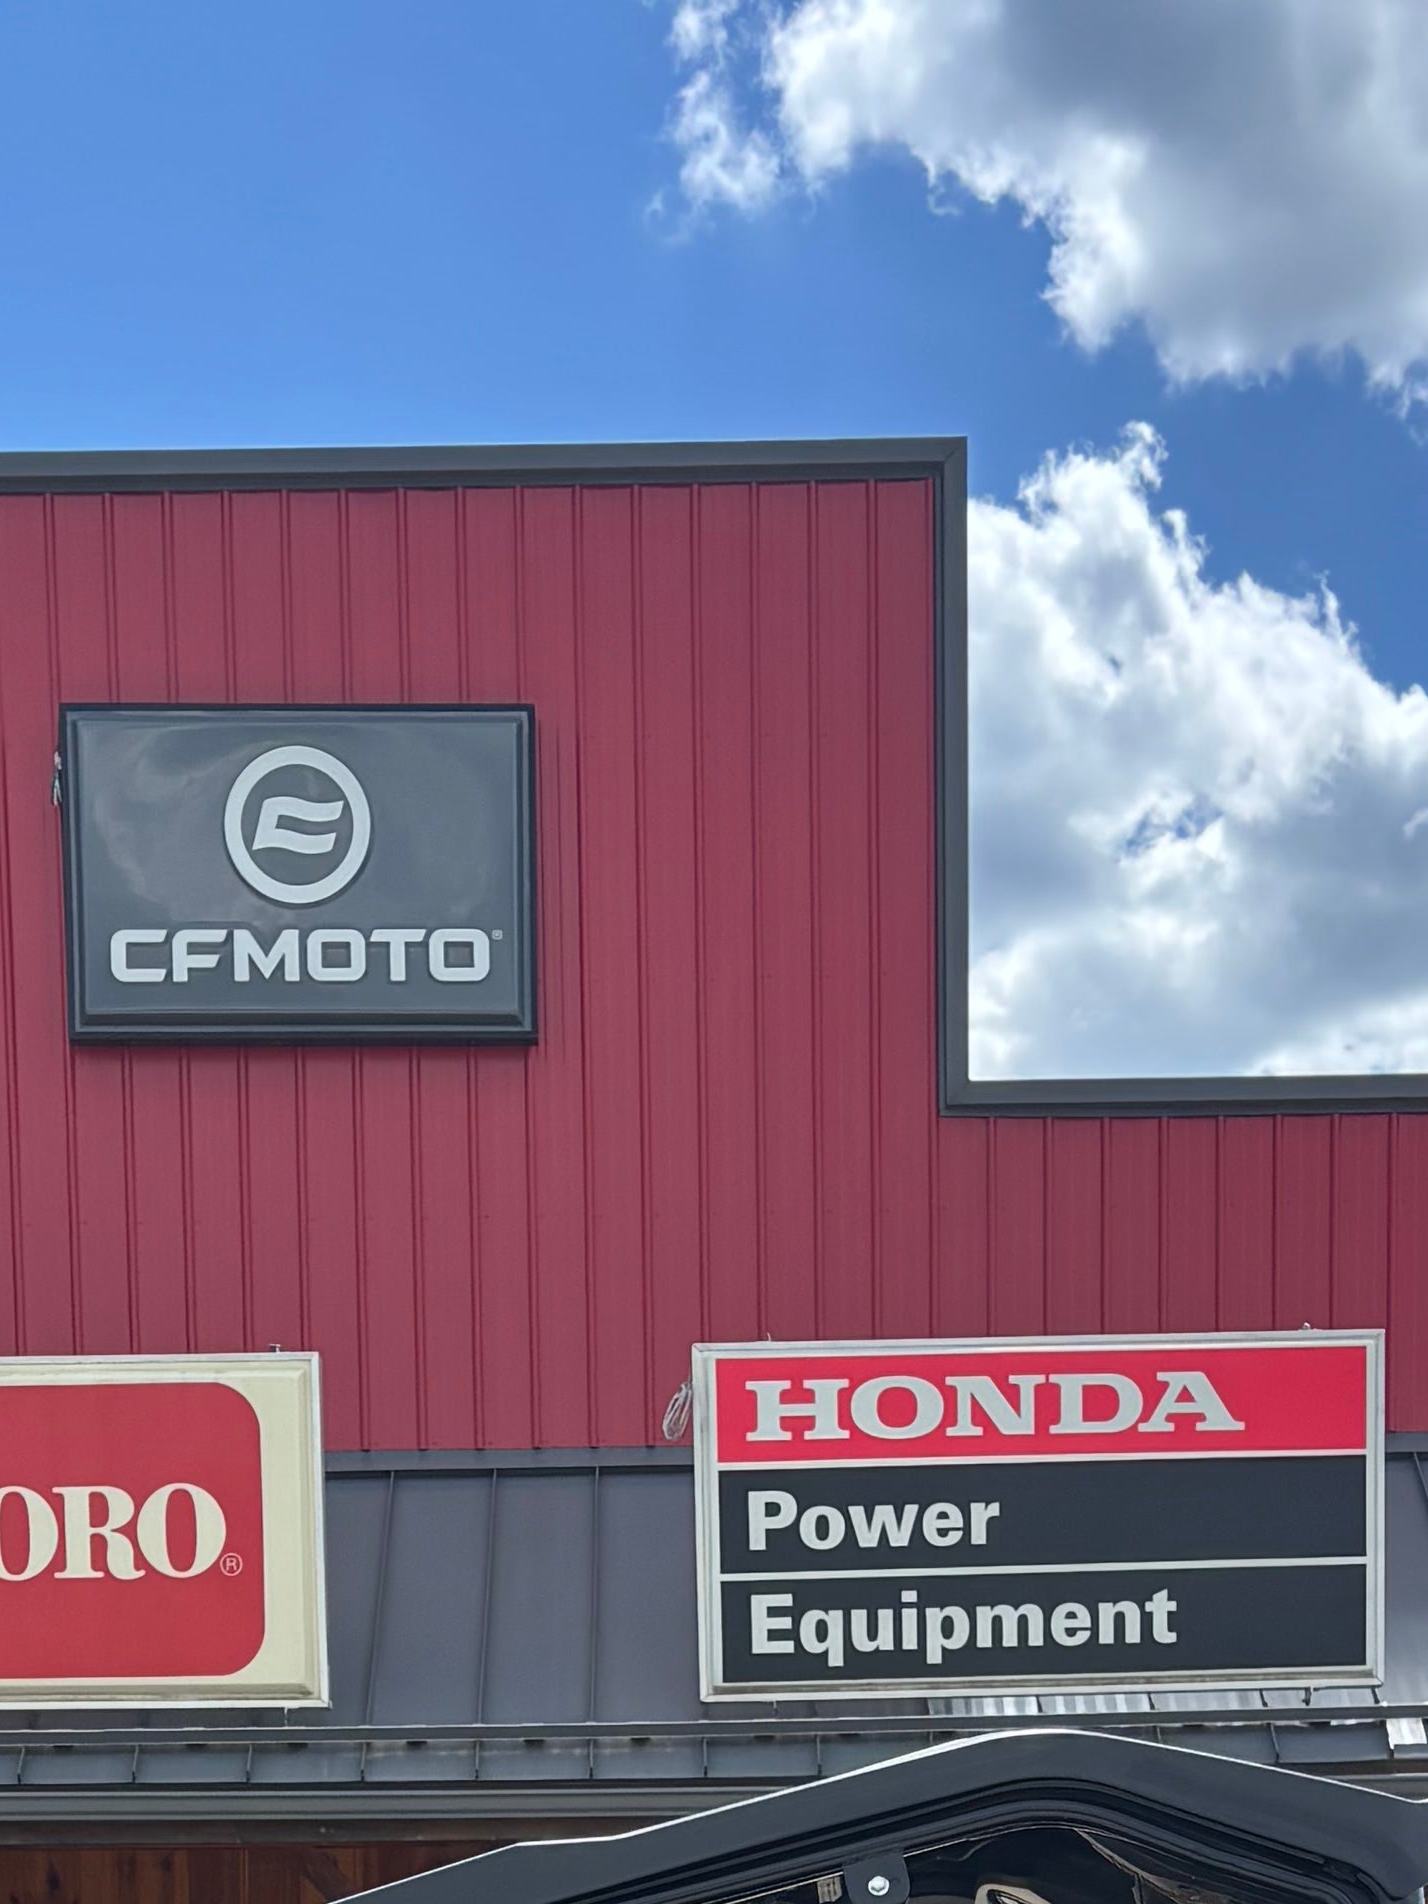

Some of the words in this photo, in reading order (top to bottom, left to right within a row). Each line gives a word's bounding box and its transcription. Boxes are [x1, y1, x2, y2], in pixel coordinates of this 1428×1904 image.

[110, 929, 492, 983] CFMOTO
[745, 1371, 1245, 1442] HONDA
[748, 1489, 1001, 1551] Power
[750, 1589, 1178, 1667] Equipment
